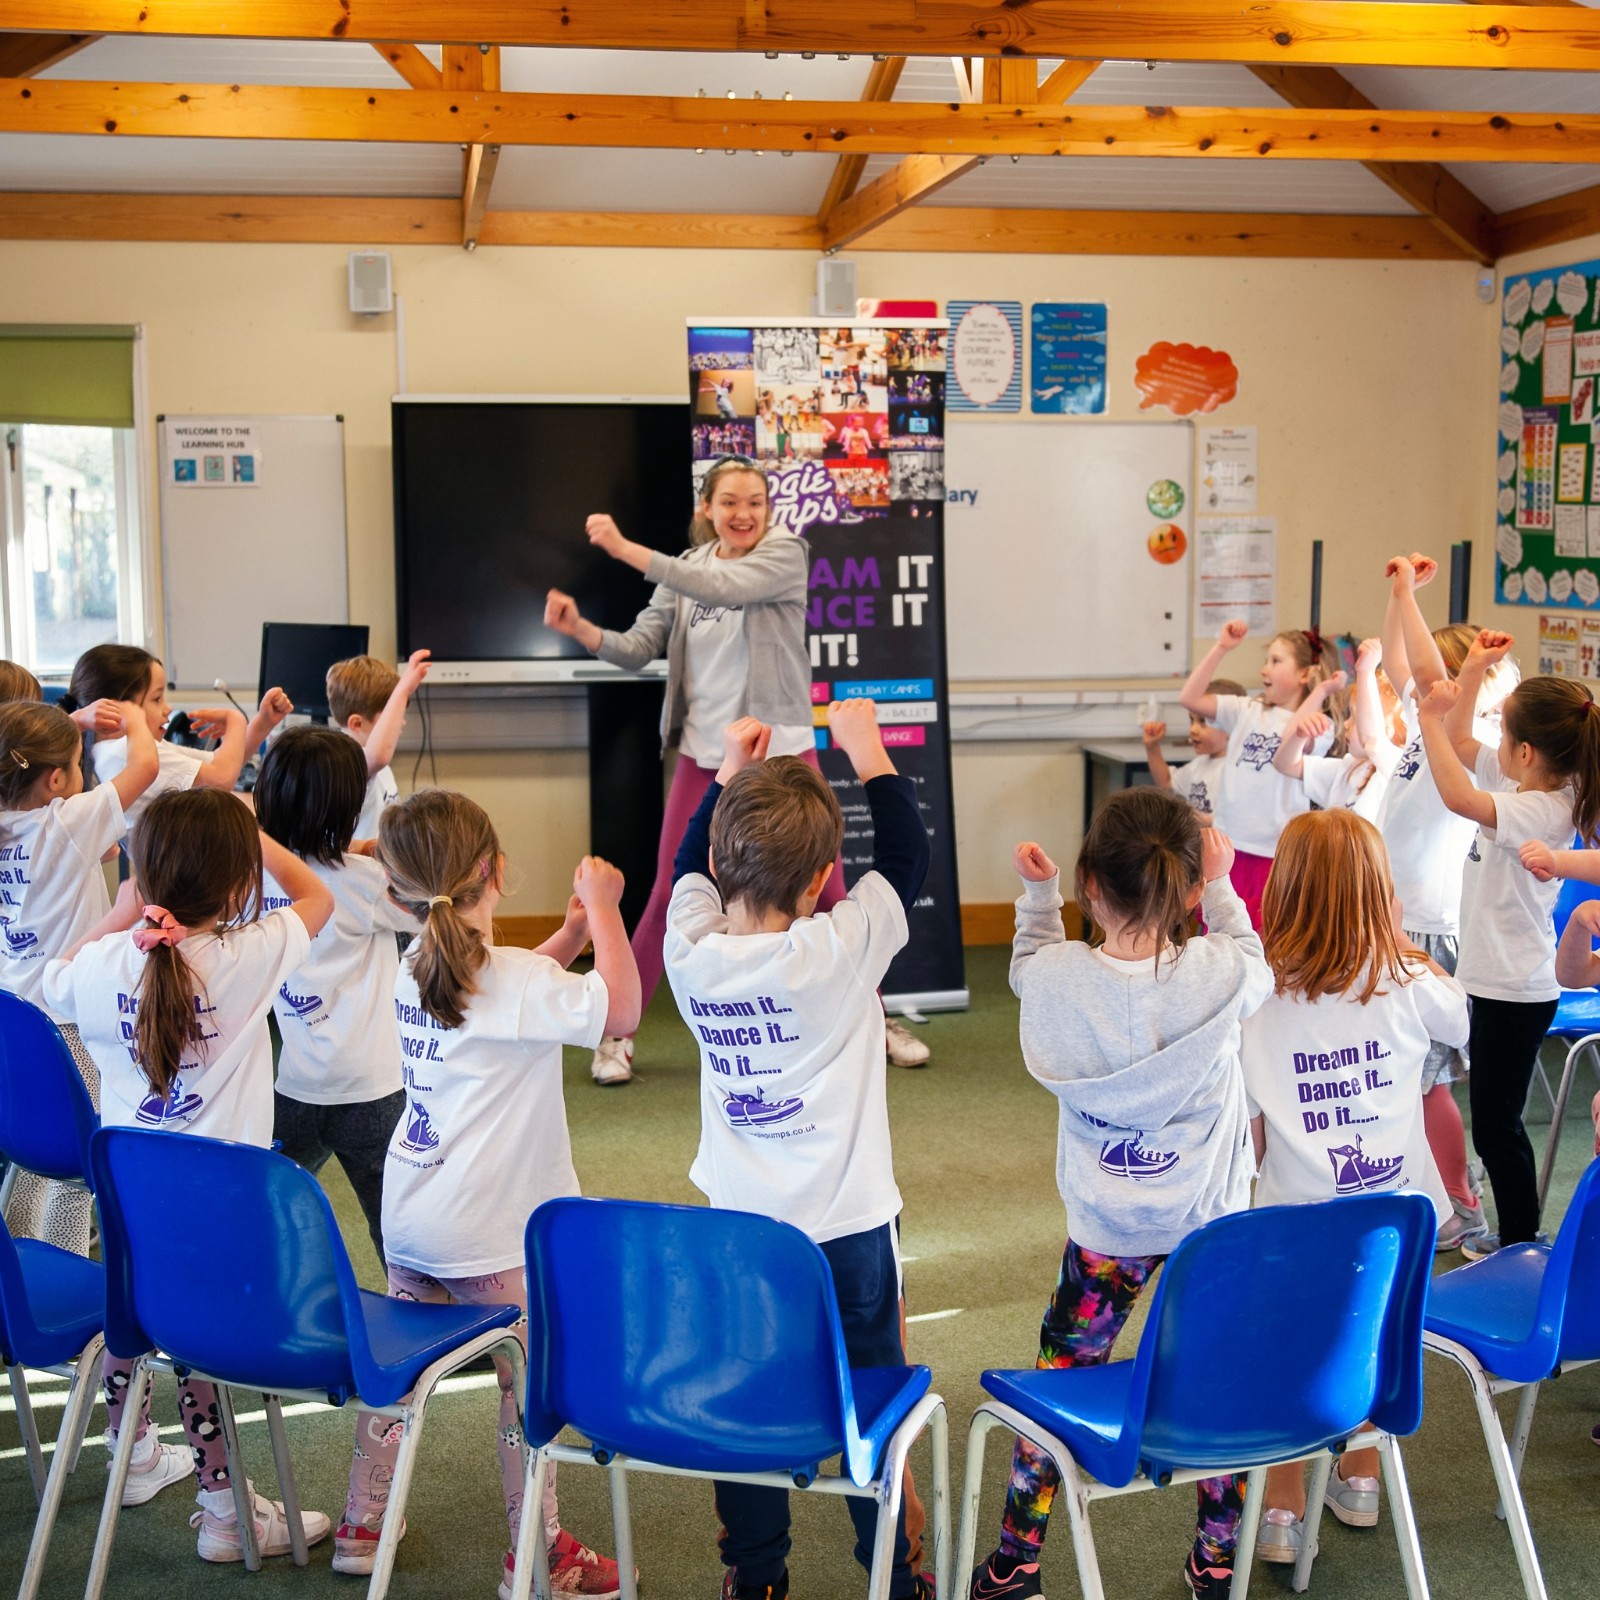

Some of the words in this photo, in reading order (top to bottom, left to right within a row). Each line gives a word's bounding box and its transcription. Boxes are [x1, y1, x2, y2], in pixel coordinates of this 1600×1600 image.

[175, 427, 218, 436] WELCOME
[221, 427, 233, 436] TO
[235, 427, 250, 436] THE
[181, 441, 224, 449] LEARNING
[226, 441, 245, 449] HUB
[898, 555, 934, 588] IT
[805, 595, 876, 627] NCE
[892, 593, 928, 627] IT
[1539, 616, 1576, 641] Ratio
[809, 633, 860, 667] IT!
[846, 686, 887, 696] HOLIDAY
[890, 684, 921, 694] CAMPS
[892, 708, 929, 718] BALLET
[884, 731, 913, 742] DANCE
[260, 896, 293, 911] ream
[689, 995, 756, 1017] Dream
[697, 1024, 762, 1046] Dance
[708, 1051, 731, 1076] Do
[1293, 1047, 1360, 1074] Dream
[1297, 1077, 1362, 1103] Dance
[1302, 1111, 1330, 1134] Do
